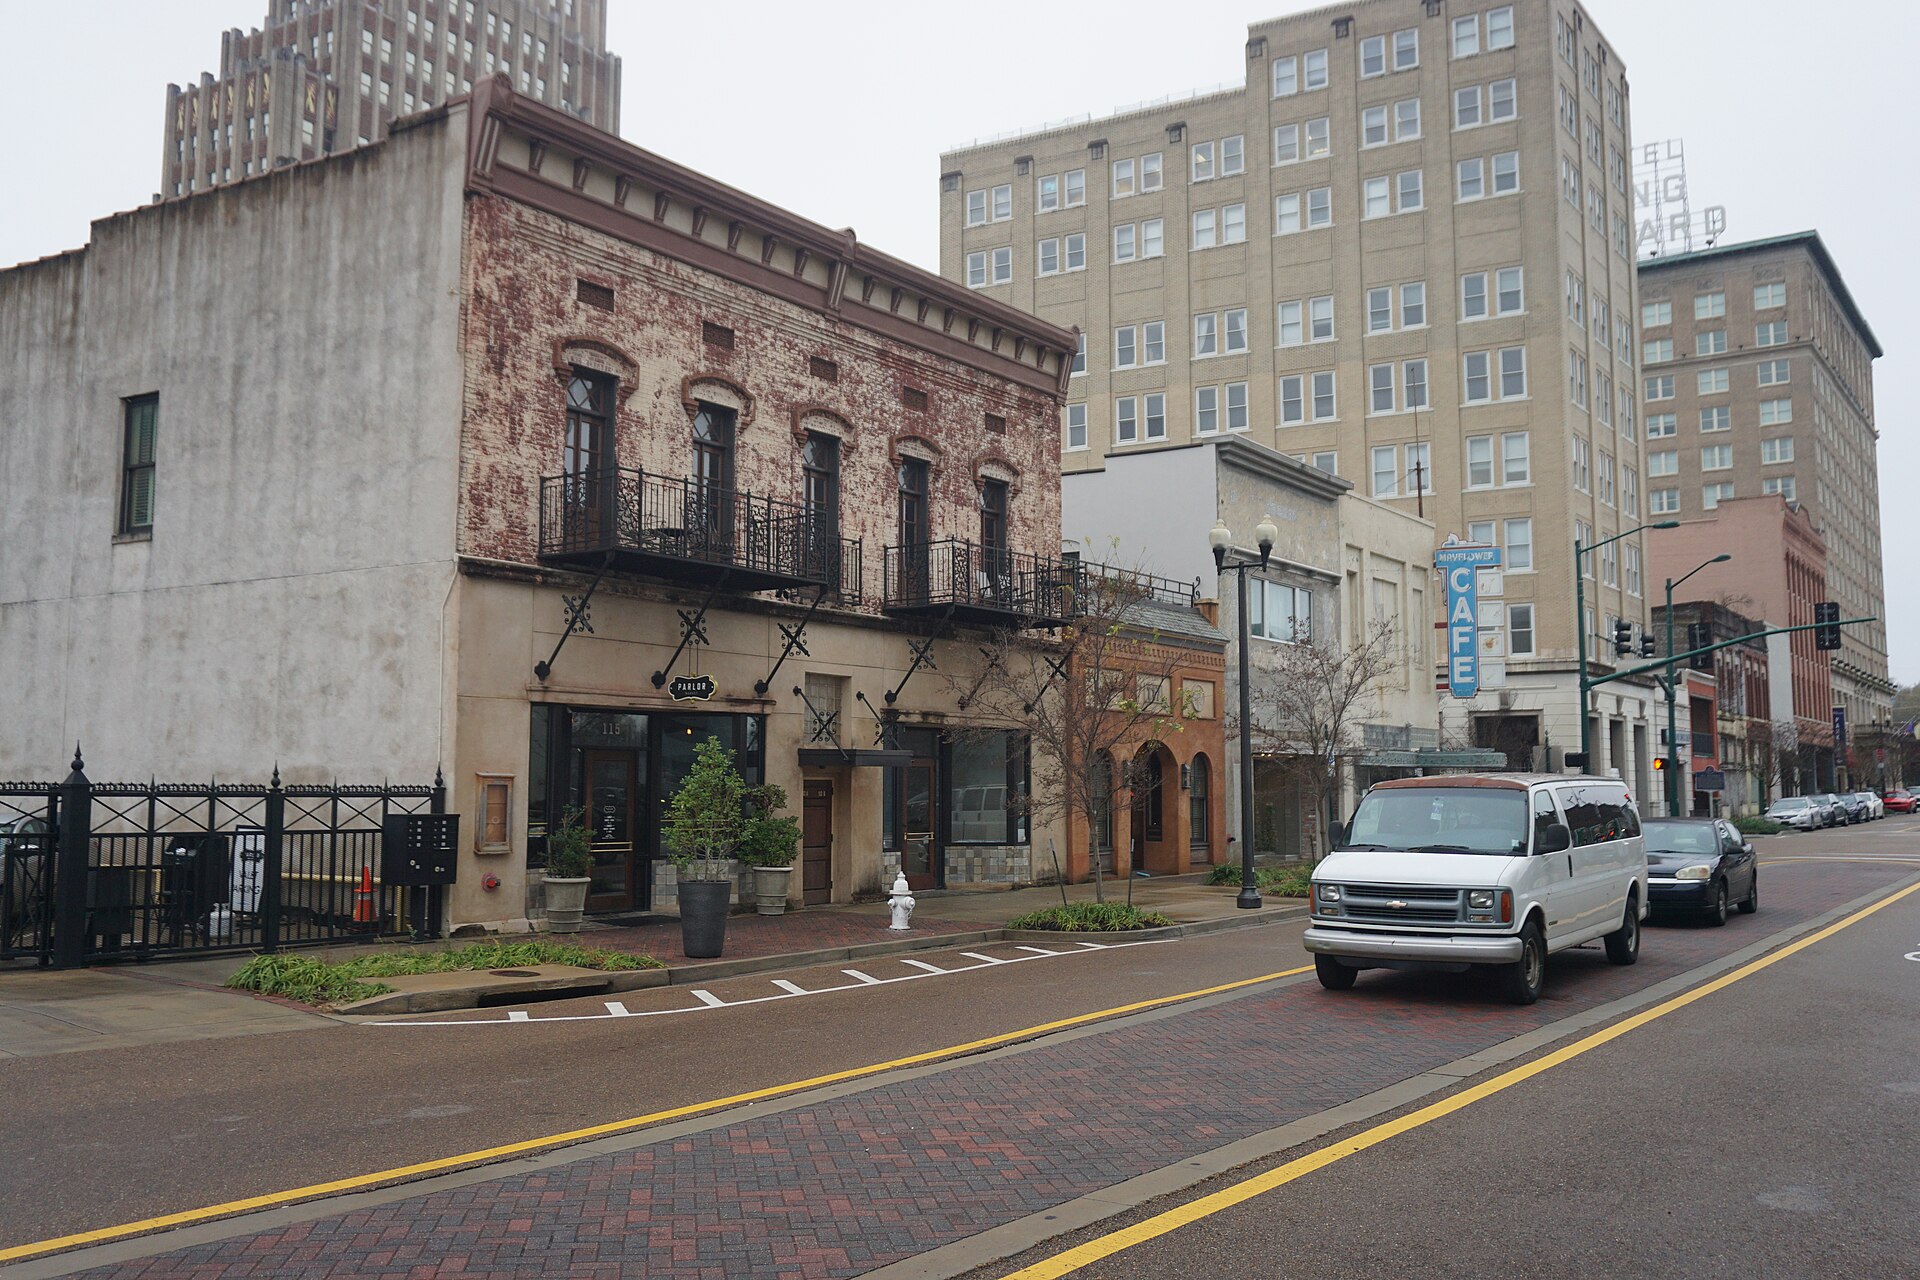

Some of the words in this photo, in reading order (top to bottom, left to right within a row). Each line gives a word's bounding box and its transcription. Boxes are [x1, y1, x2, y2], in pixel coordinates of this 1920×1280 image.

[1439, 551, 1495, 562] MAYFLOWER
[1450, 567, 1475, 683] CAFE
[678, 682, 706, 691] PARLOR
[602, 722, 621, 735] 115
